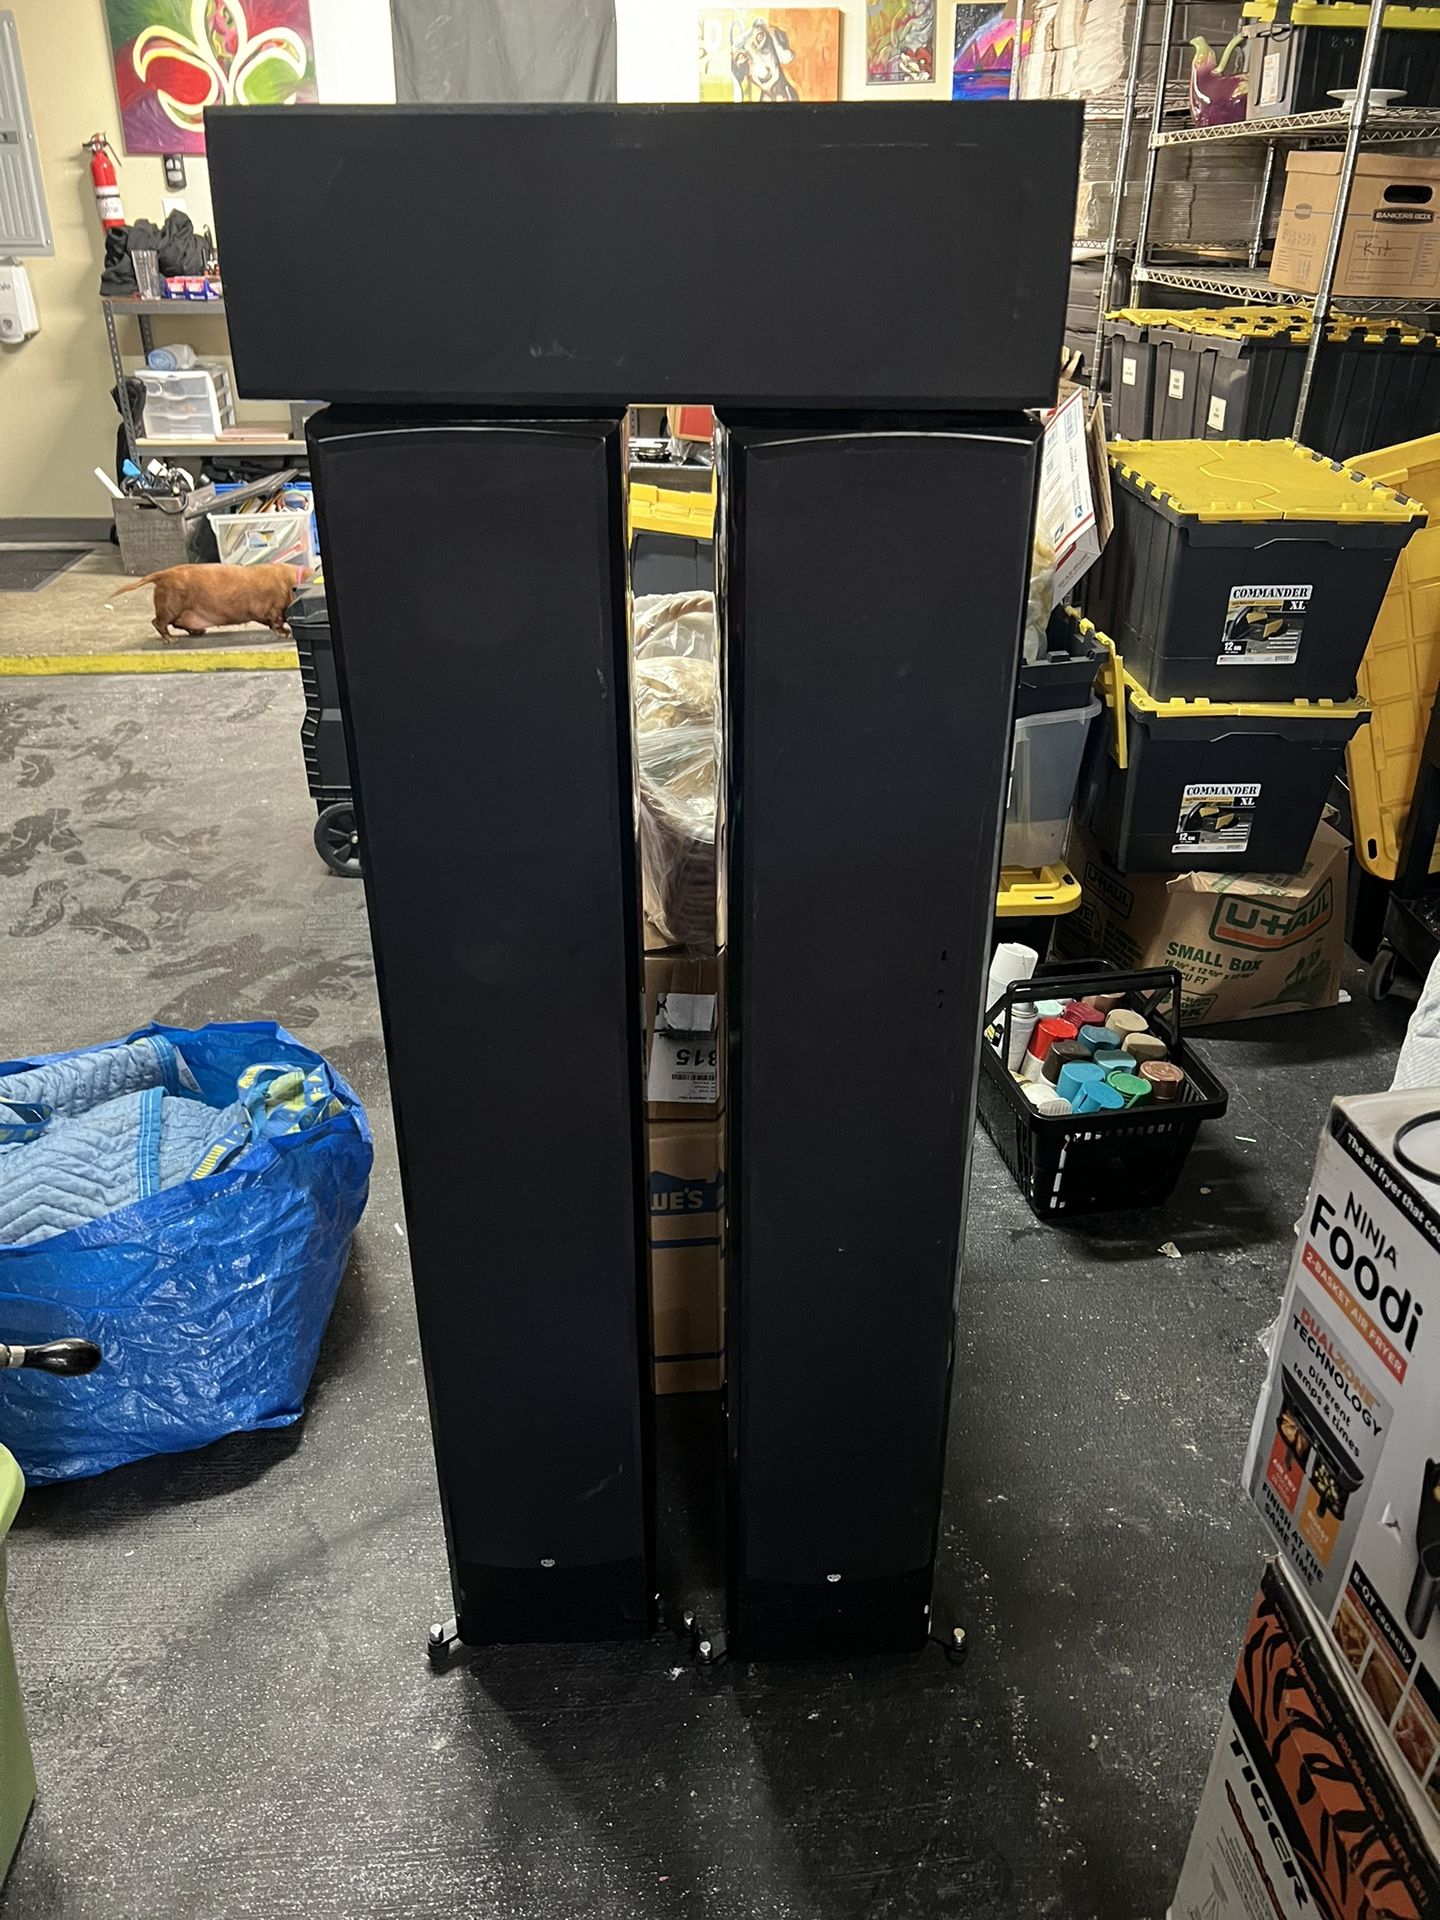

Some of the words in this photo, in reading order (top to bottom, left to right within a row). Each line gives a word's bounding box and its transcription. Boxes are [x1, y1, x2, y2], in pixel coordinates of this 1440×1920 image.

[1232, 587, 1308, 599] COMMANDER
[1289, 600, 1306, 611] XL
[1224, 642, 1233, 651] 12
[1186, 786, 1257, 796] COMMANDER
[1240, 797, 1255, 806] XL
[1179, 832, 1188, 841] 12
[1166, 941, 1223, 968] SMALL
[1229, 957, 1264, 972] BOX
[1193, 975, 1209, 986] FT
[651, 1187, 704, 1210] WE'S
[1346, 1132, 1364, 1158] The
[1364, 1154, 1379, 1173] air
[1378, 1166, 1403, 1198] fryer
[1401, 1192, 1426, 1223] that
[1343, 1191, 1399, 1270] NINJA
[1305, 1250, 1351, 1310] 2-BASKET
[1350, 1308, 1368, 1331] AIR
[1368, 1331, 1404, 1375] FRYER
[1293, 1314, 1383, 1437] TECHNOLOGY
[1308, 1365, 1351, 1427] Different
[1293, 1362, 1322, 1405] temps
[1332, 1416, 1360, 1457] times
[1262, 1482, 1292, 1530] FINISH
[1291, 1530, 1305, 1549] AT
[1305, 1549, 1325, 1583] THE
[1264, 1502, 1290, 1547] SAME
[1290, 1545, 1315, 1587] TIME
[1374, 1607, 1413, 1665] capacity
[1229, 1728, 1309, 1911] TIGER
